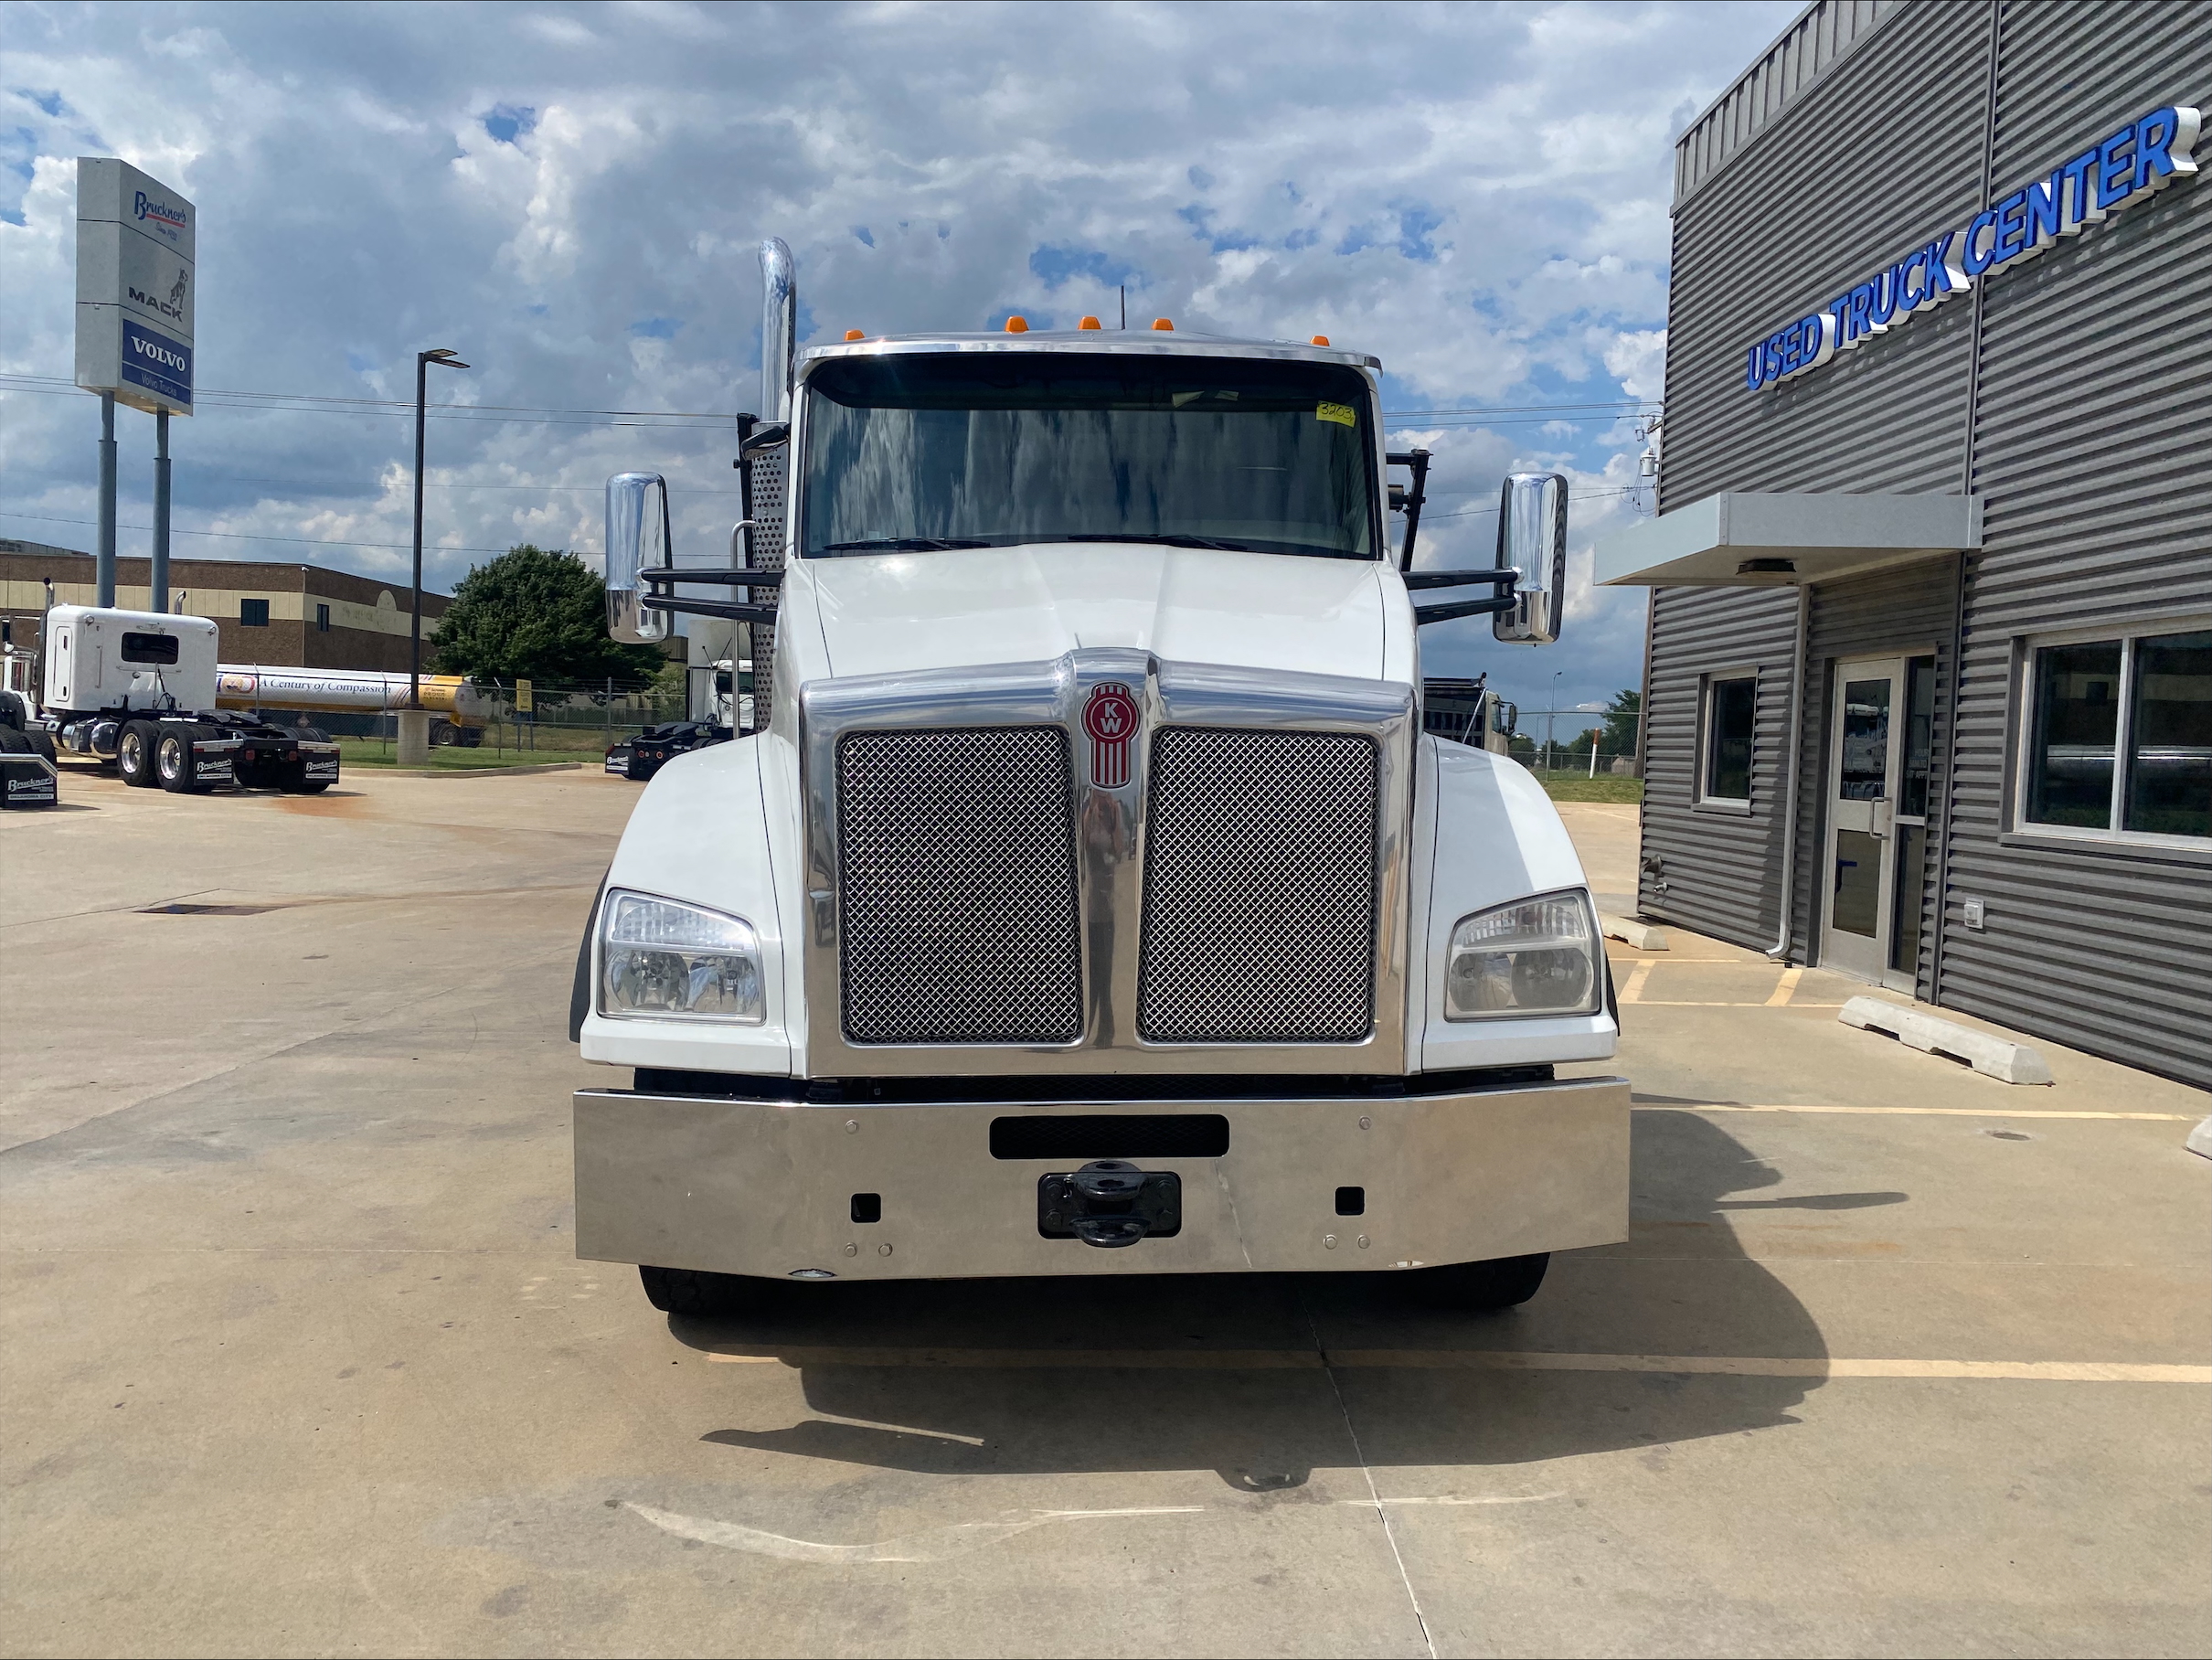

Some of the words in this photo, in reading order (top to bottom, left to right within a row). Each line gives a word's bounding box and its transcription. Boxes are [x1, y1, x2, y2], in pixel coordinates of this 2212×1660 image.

[133, 190, 186, 224] Bruckner's
[1747, 314, 1826, 391] USED
[1829, 230, 1960, 349] TRUCK
[1963, 106, 2185, 275] CENTER
[129, 286, 183, 323] MACK
[131, 335, 186, 372] VOLVO
[141, 373, 158, 389] Volvo
[159, 379, 177, 397] Trucks
[259, 678, 268, 686] A
[270, 678, 311, 692] Century
[314, 681, 328, 693] of
[327, 682, 391, 695] Compassion
[7, 775, 54, 793] Bruckner's
